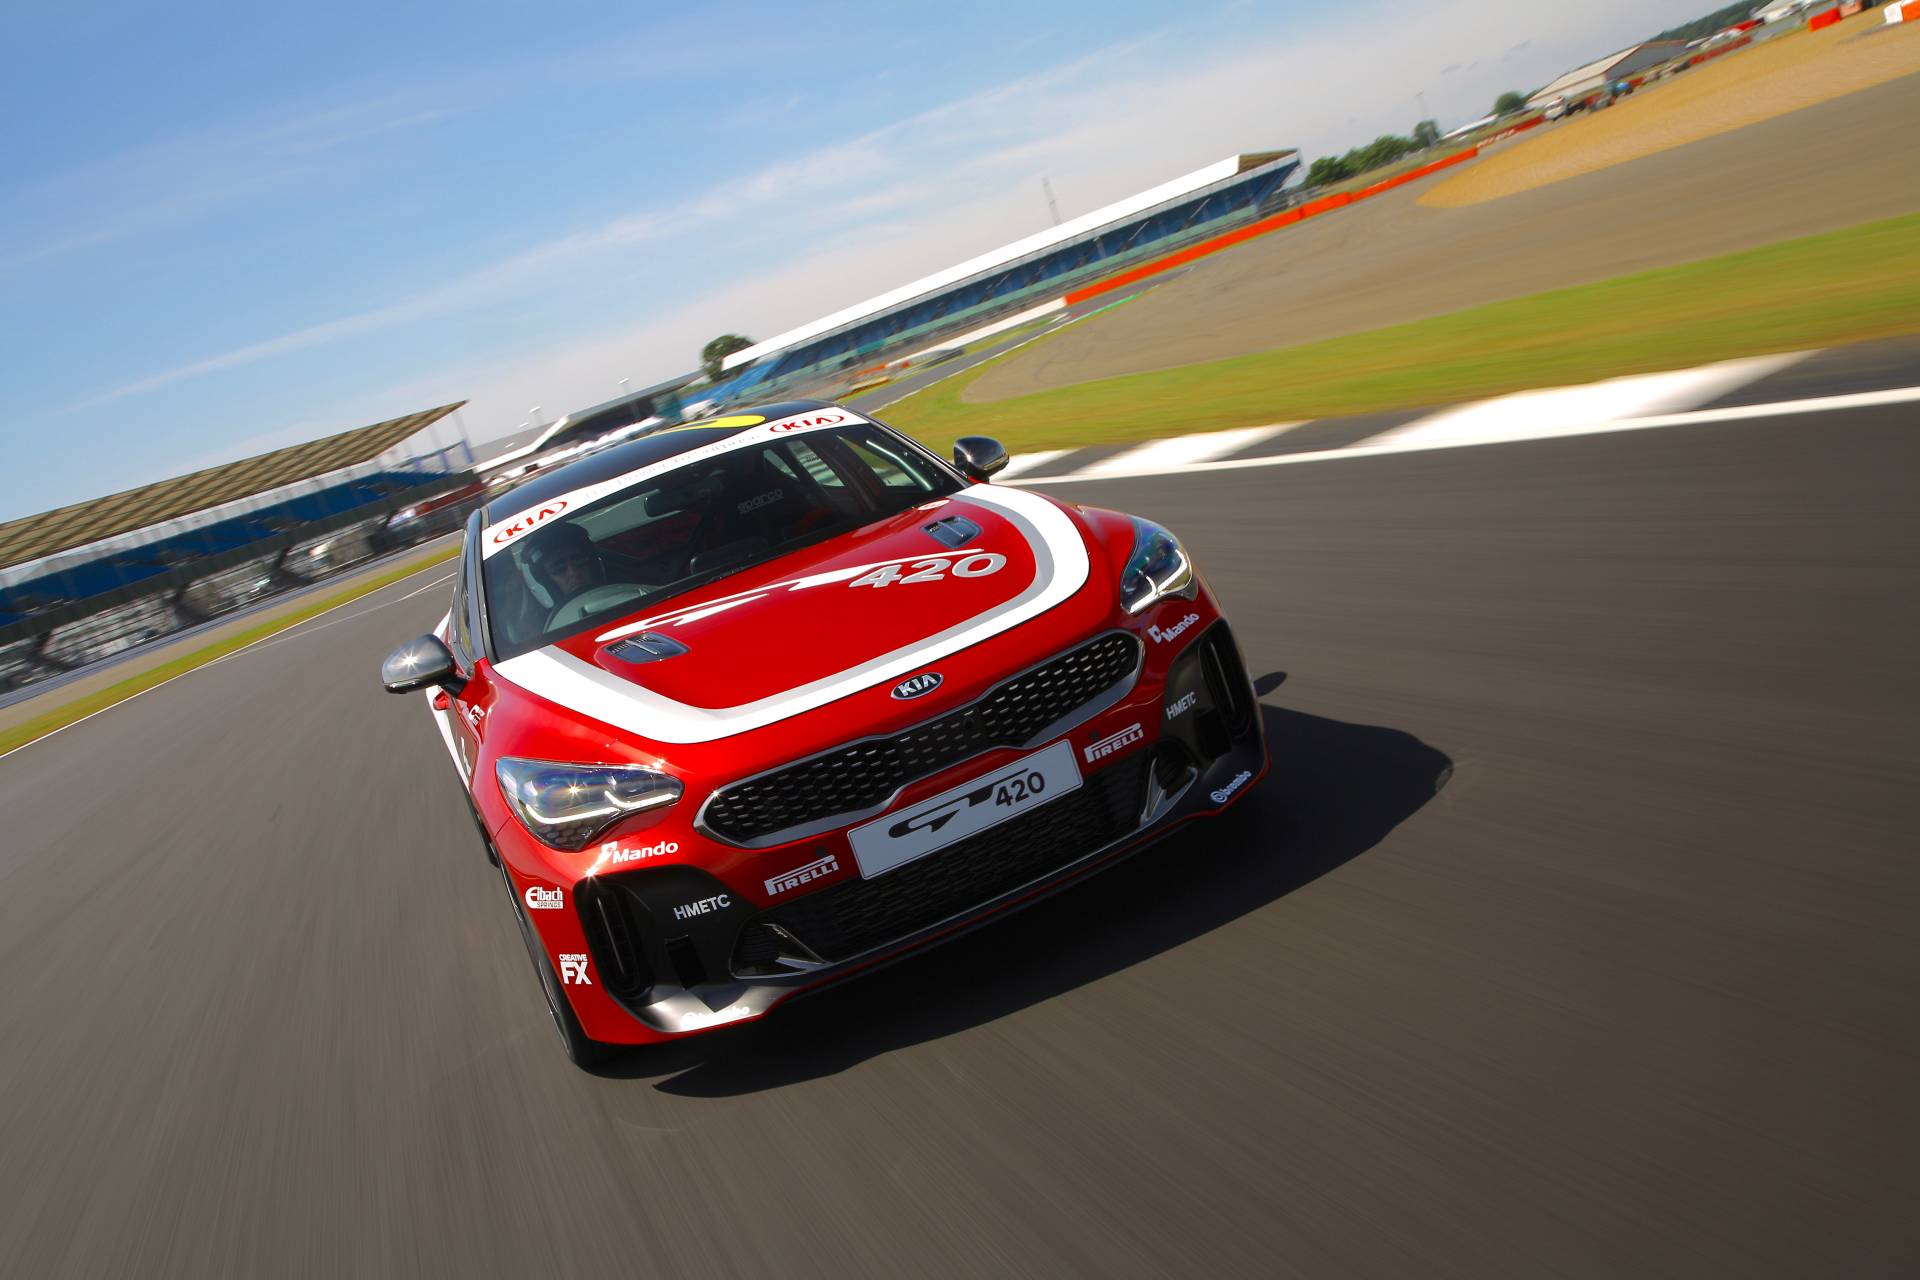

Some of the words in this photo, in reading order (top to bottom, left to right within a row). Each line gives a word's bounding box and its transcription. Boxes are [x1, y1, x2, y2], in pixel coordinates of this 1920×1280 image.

[849, 552, 1008, 588] 420
[1161, 613, 1200, 642] Mando
[897, 674, 938, 697] KIA
[1165, 692, 1197, 720] HMETC
[1083, 722, 1144, 764] PIRELLI
[995, 771, 1046, 807] 420
[612, 841, 679, 864] Mando
[764, 854, 839, 896] PIRELLI
[673, 894, 731, 920] HMETC
[559, 954, 588, 962] CREATIVE
[560, 962, 592, 984] FX
